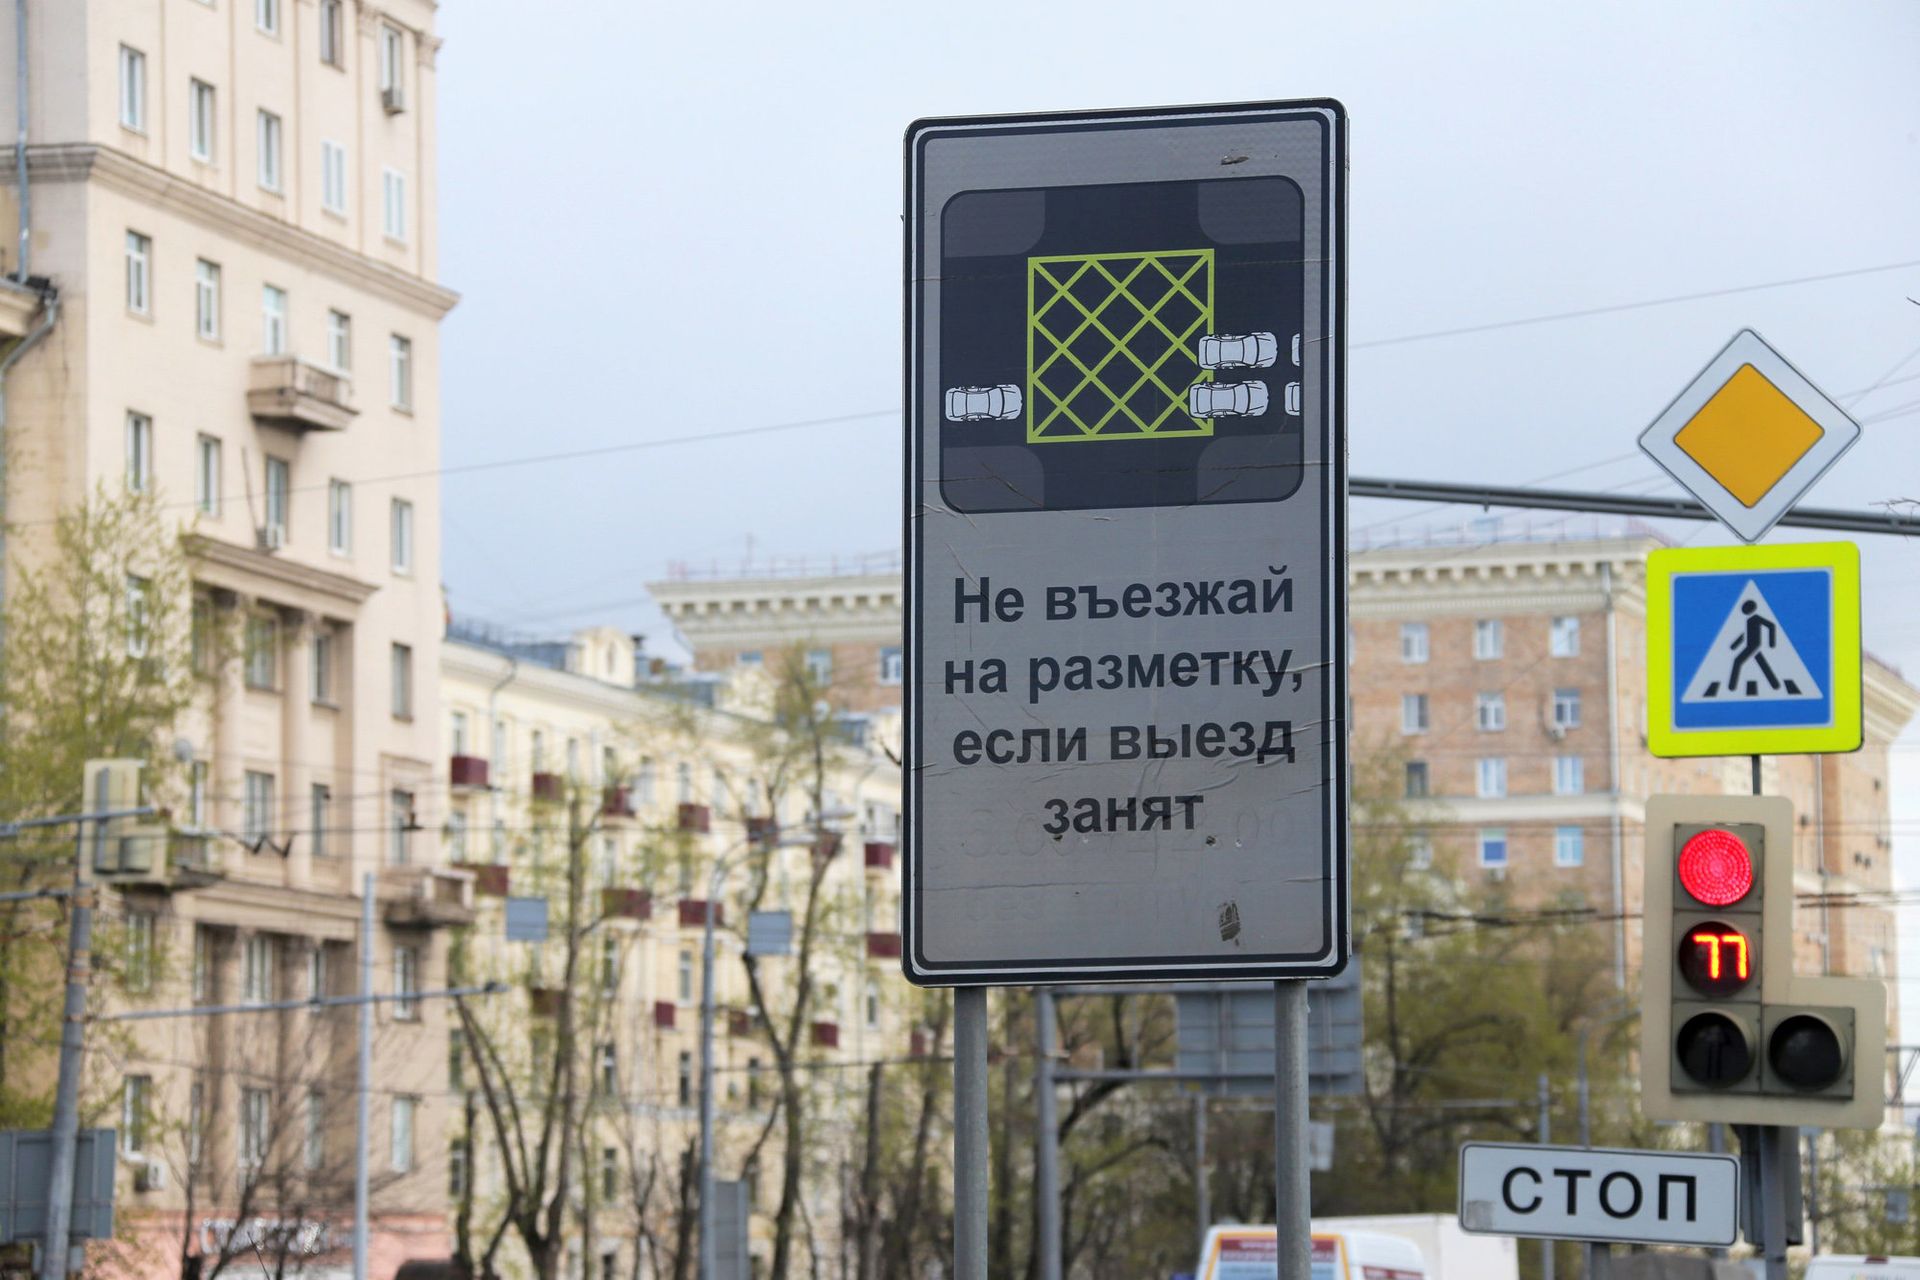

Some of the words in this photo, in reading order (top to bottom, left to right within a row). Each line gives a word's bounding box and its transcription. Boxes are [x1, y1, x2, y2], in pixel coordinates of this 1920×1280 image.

[955, 577, 1024, 623] Не
[1047, 565, 1292, 620] въезжай
[945, 659, 1007, 694] на
[1030, 650, 1302, 704] разметку,
[954, 727, 1086, 765] если
[1111, 721, 1295, 764] выезд
[1043, 795, 1203, 834] занят
[1694, 934, 1748, 980] 77
[1502, 1167, 1696, 1221] СТОП
